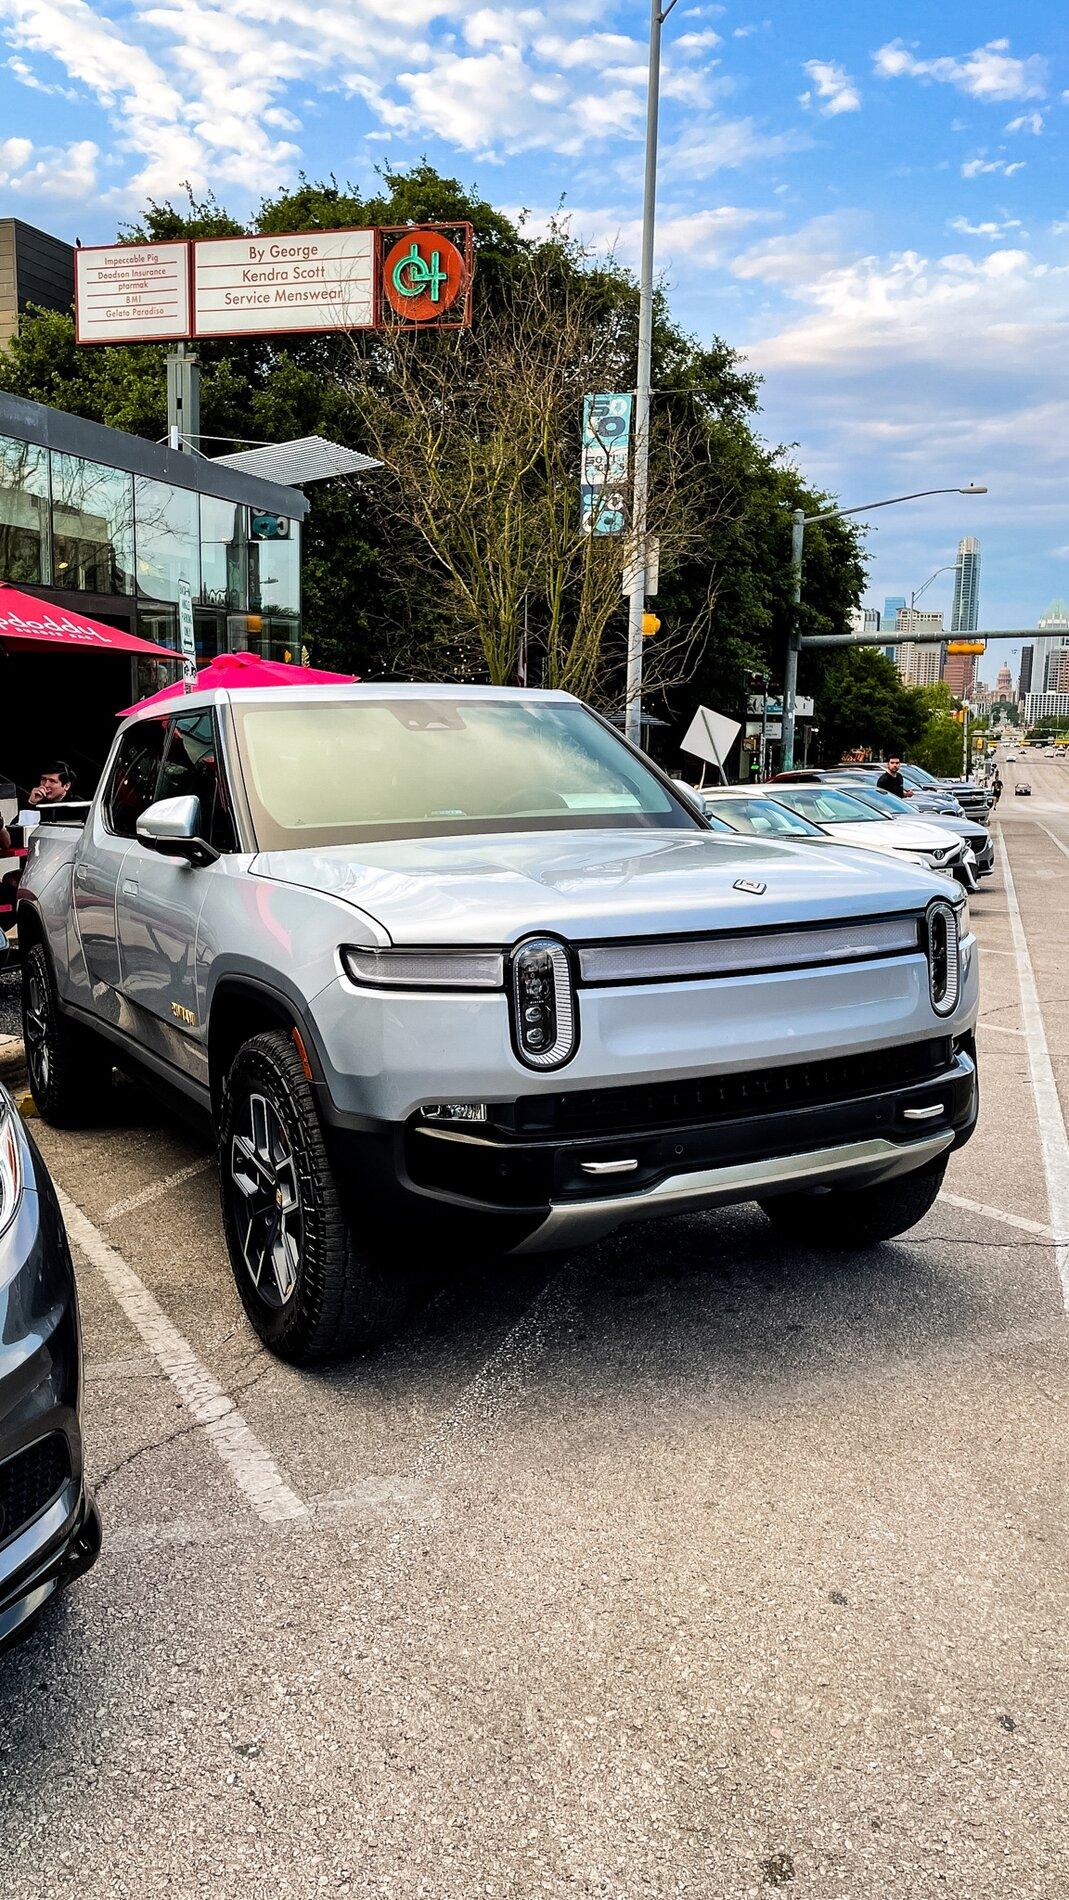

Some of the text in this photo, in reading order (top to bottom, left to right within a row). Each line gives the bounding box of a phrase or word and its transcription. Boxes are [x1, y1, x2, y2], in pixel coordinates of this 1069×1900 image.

[104, 254, 159, 266] Impeccable Pig
[249, 244, 318, 262] By George
[131, 268, 166, 277] Insurance
[242, 265, 325, 282] Kendra Scott
[224, 289, 343, 305] Service Menswear
[105, 307, 165, 318] Gelato Paradiso
